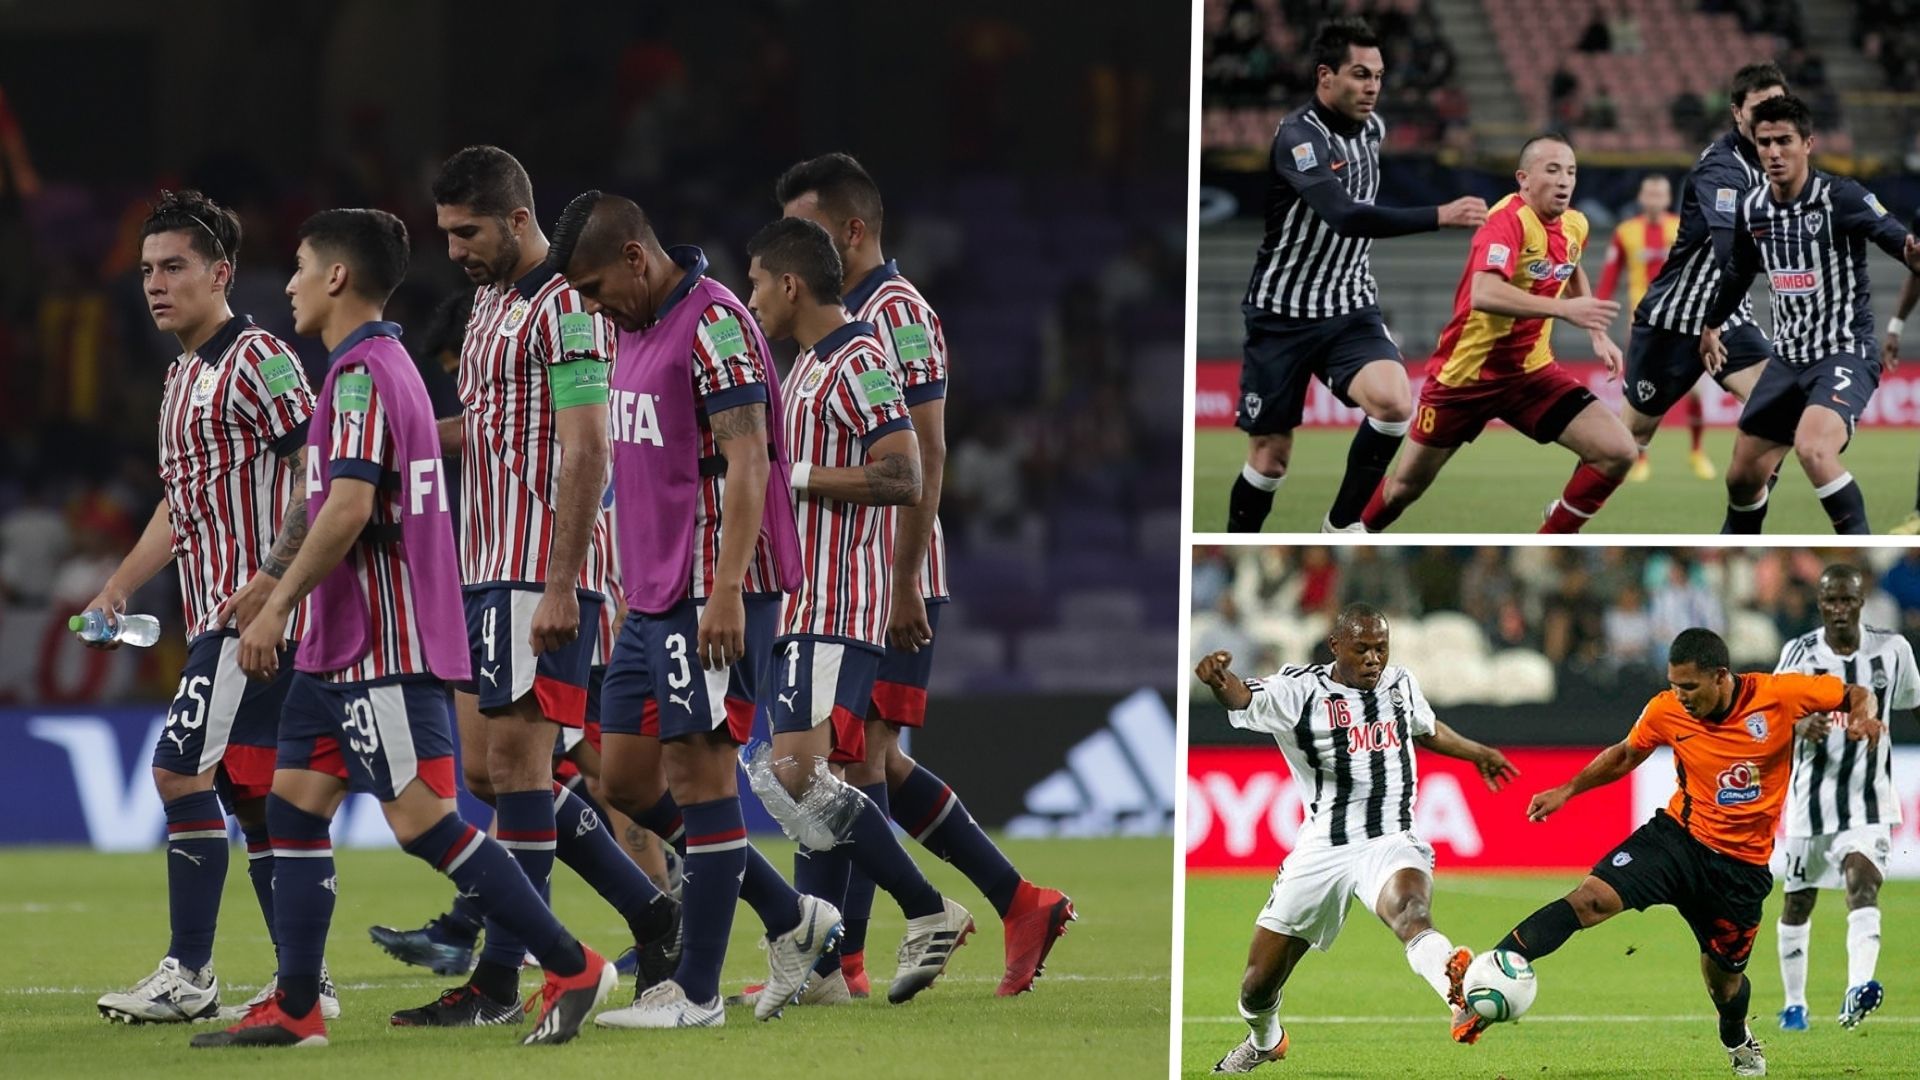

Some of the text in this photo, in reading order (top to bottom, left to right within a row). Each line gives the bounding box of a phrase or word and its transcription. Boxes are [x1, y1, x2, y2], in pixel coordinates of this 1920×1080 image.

[1773, 273, 1816, 289] BIMBO
[1832, 366, 1854, 391] 5
[608, 388, 665, 448] IFA
[1416, 405, 1436, 433] 18
[410, 458, 449, 515] FI
[482, 606, 496, 662] 4
[665, 633, 692, 690] 3
[165, 675, 211, 730] 25
[341, 697, 379, 754] 29
[1323, 699, 1352, 729] 16
[1348, 720, 1401, 755] MCK
